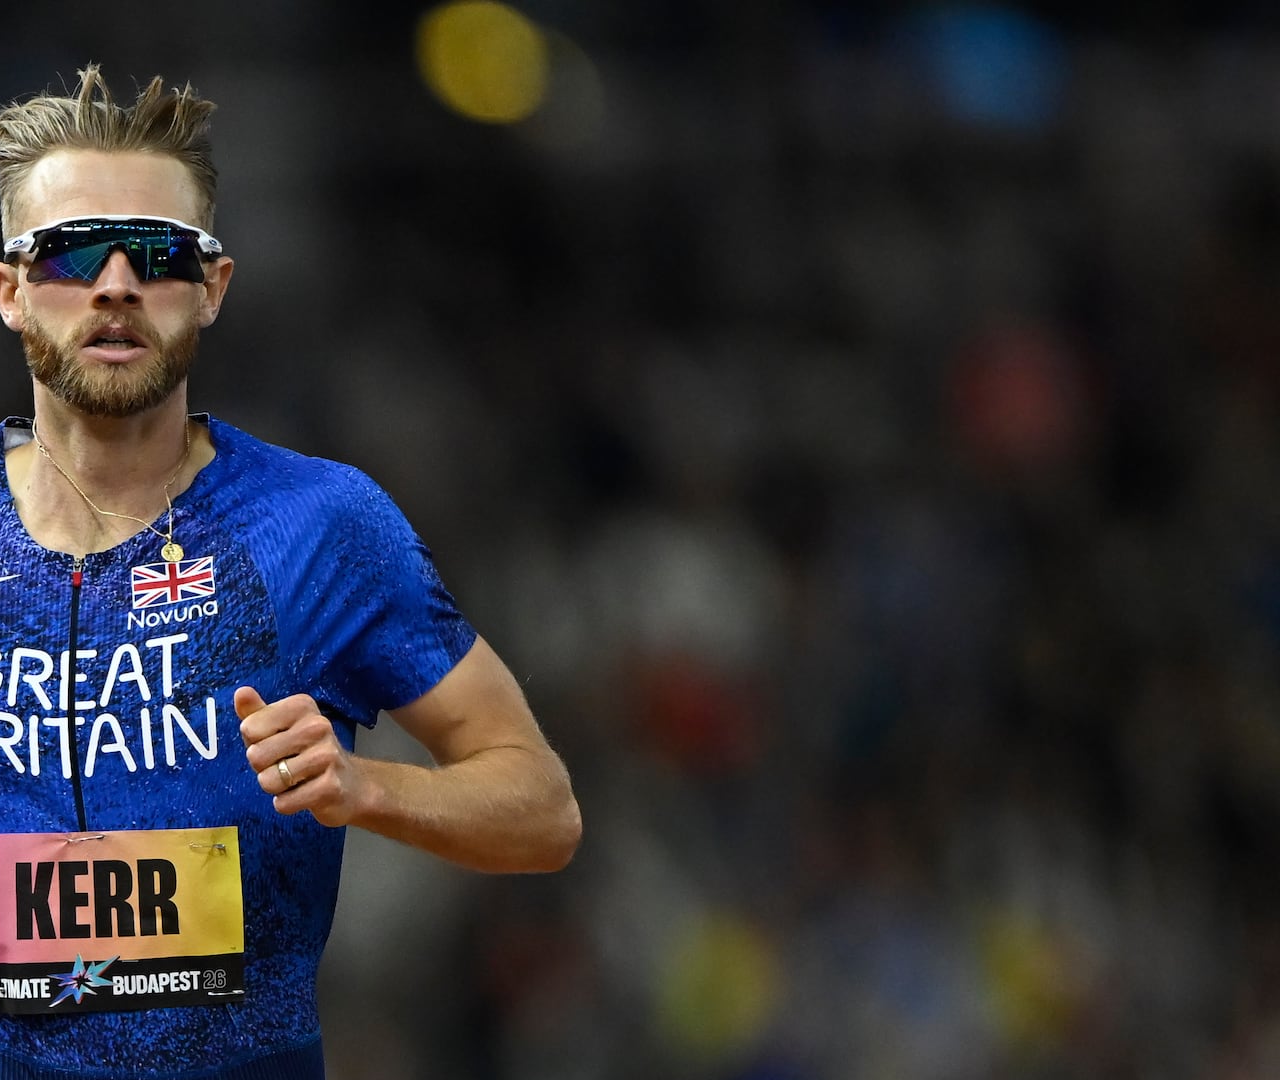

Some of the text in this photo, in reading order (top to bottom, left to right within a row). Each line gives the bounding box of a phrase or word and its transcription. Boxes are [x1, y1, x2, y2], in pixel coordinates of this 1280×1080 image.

[127, 600, 218, 630] Novuna
[15, 859, 180, 940] KERR
[112, 970, 201, 995] BUDAPEST
[203, 969, 227, 989] 26
